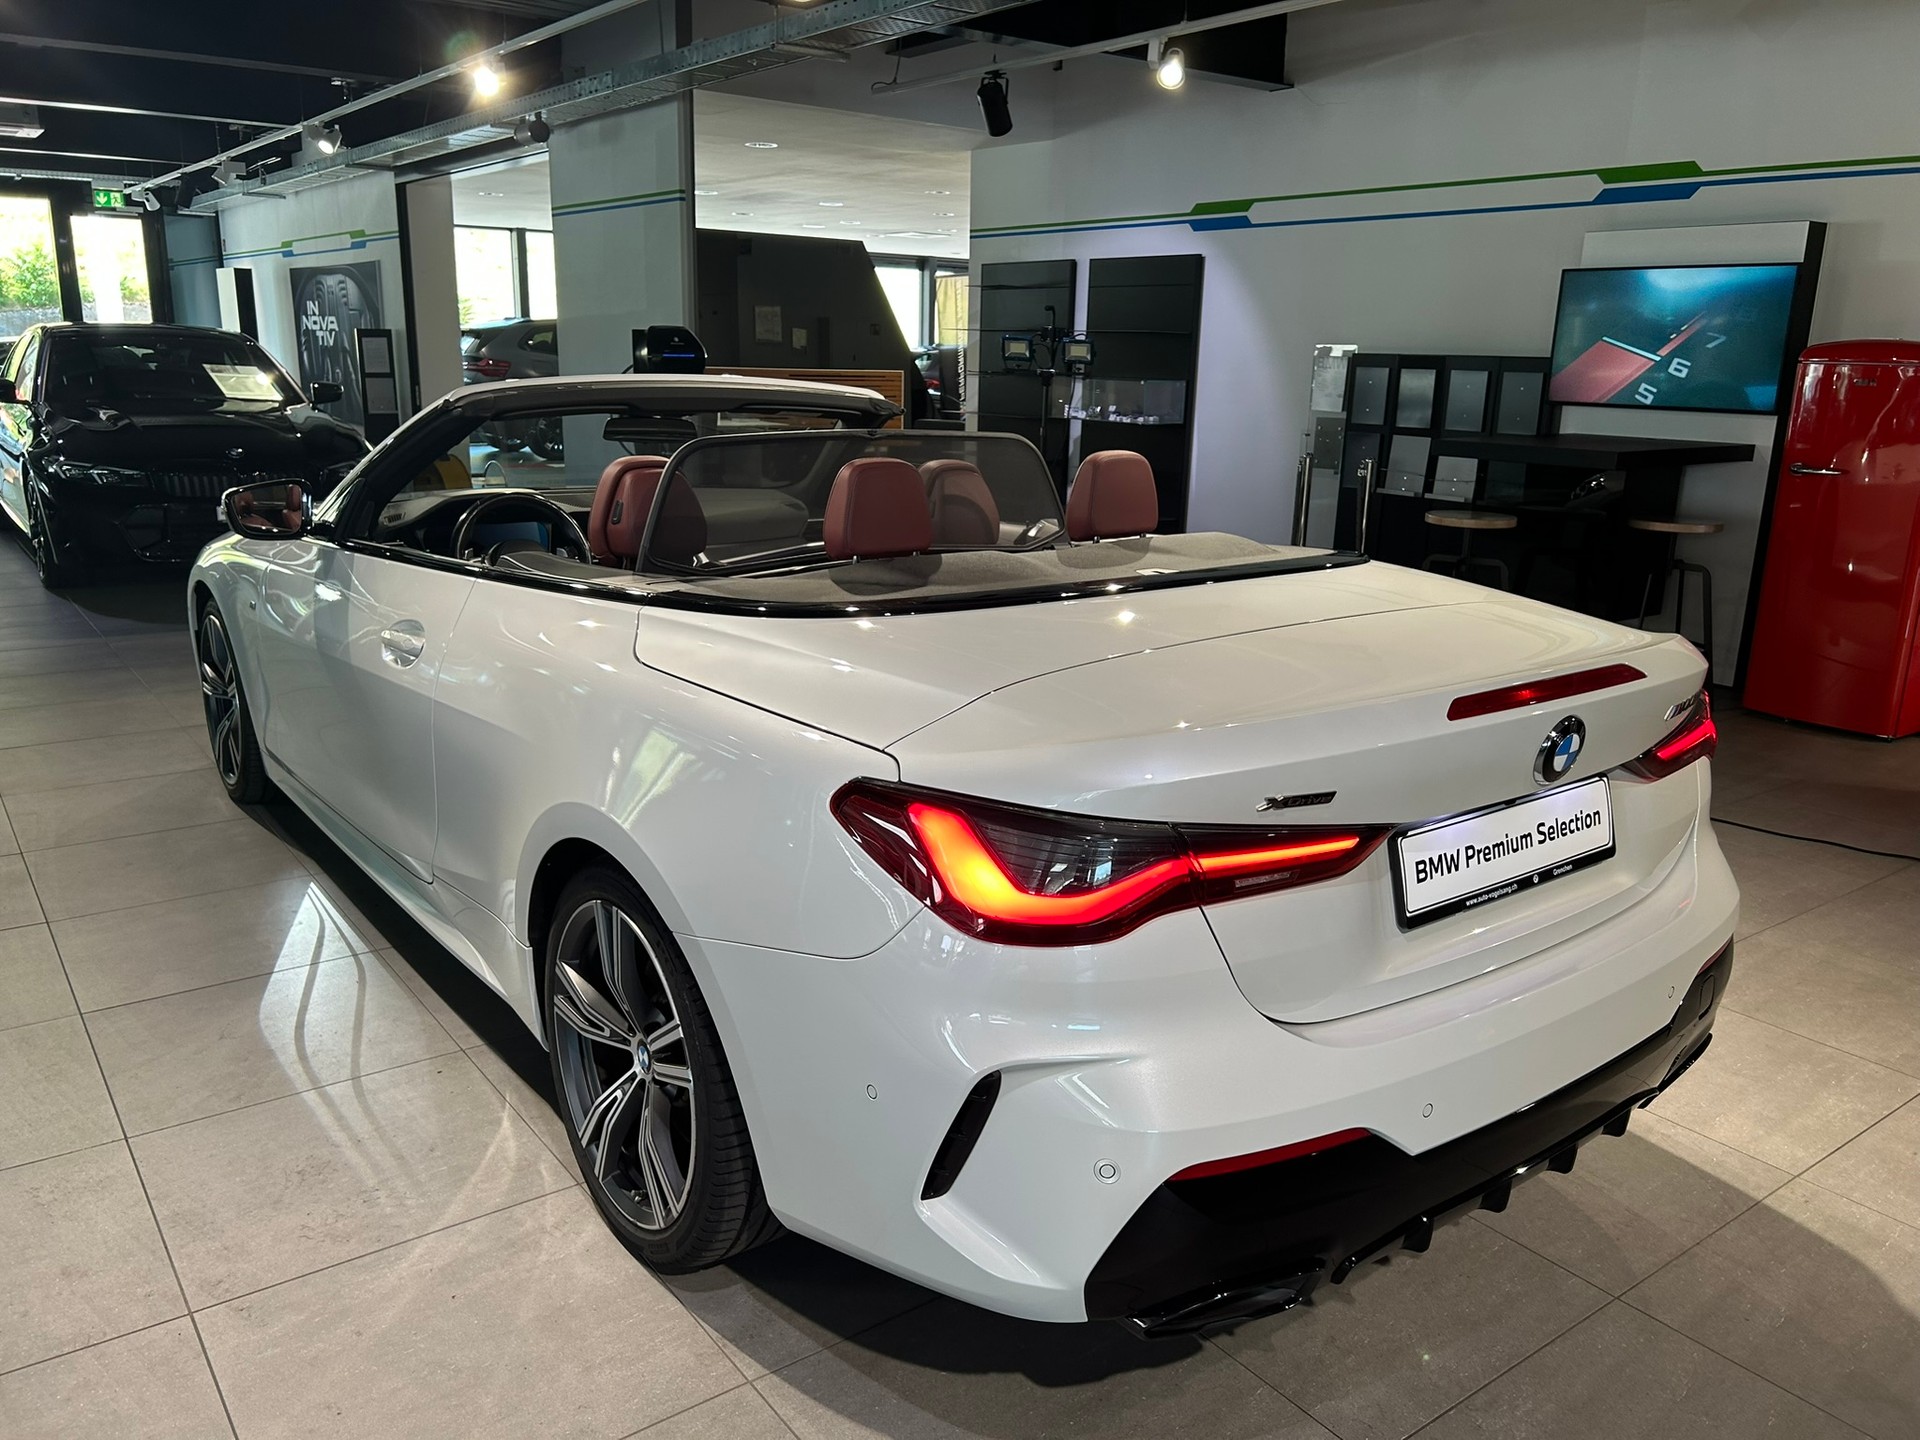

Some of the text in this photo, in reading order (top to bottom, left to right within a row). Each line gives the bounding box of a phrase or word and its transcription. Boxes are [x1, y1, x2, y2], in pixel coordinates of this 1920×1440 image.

[306, 300, 319, 316] IN
[302, 315, 339, 331] NOVA
[315, 330, 335, 346] TIV
[1705, 331, 1727, 348] 7
[1667, 357, 1692, 378] 6
[1634, 382, 1658, 405] 5
[1415, 810, 1601, 884] BMW Premium Selection
